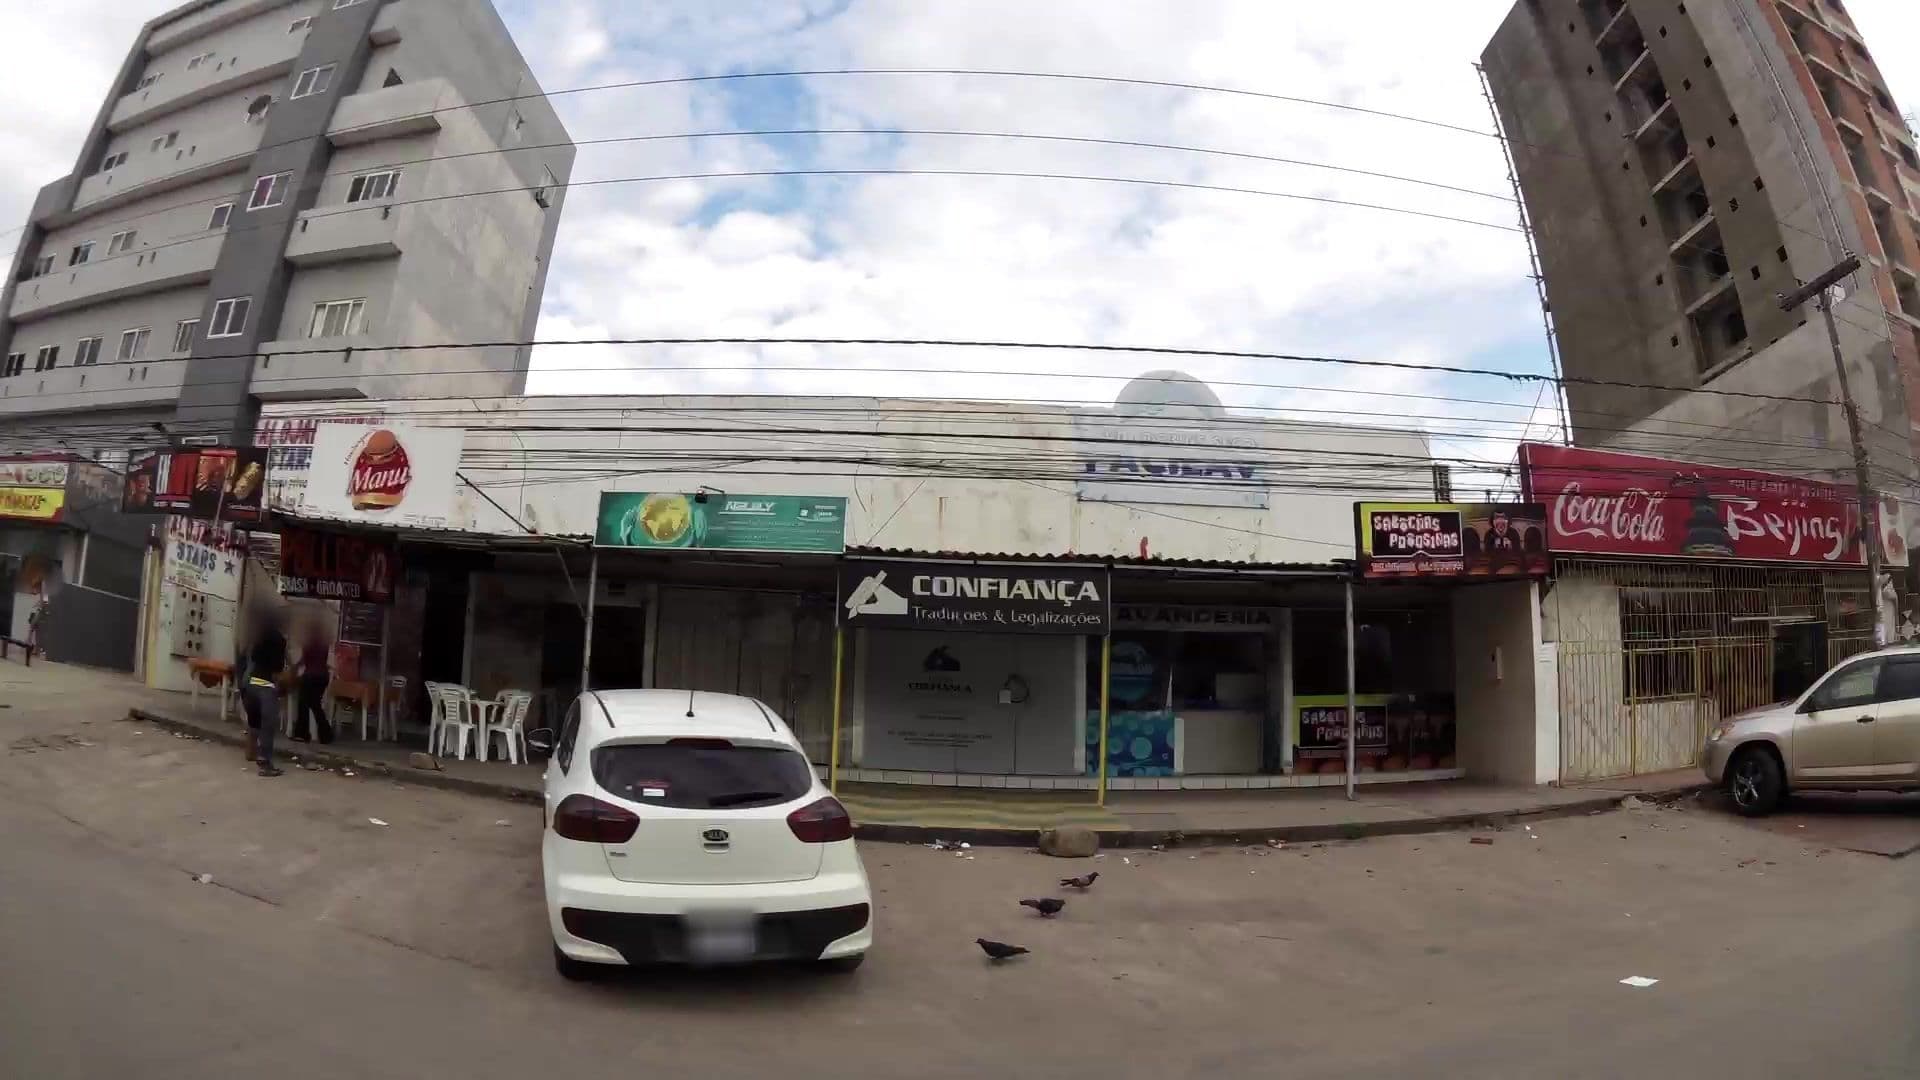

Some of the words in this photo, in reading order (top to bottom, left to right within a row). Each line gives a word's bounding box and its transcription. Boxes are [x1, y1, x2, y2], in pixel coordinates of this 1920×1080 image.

[353, 466, 410, 492] Manu
[1722, 497, 1843, 560] Beijing
[176, 543, 217, 571] STARS
[912, 575, 1100, 607] CONFIANÇA
[993, 609, 1008, 624] &
[1011, 609, 1102, 626] Legalizações
